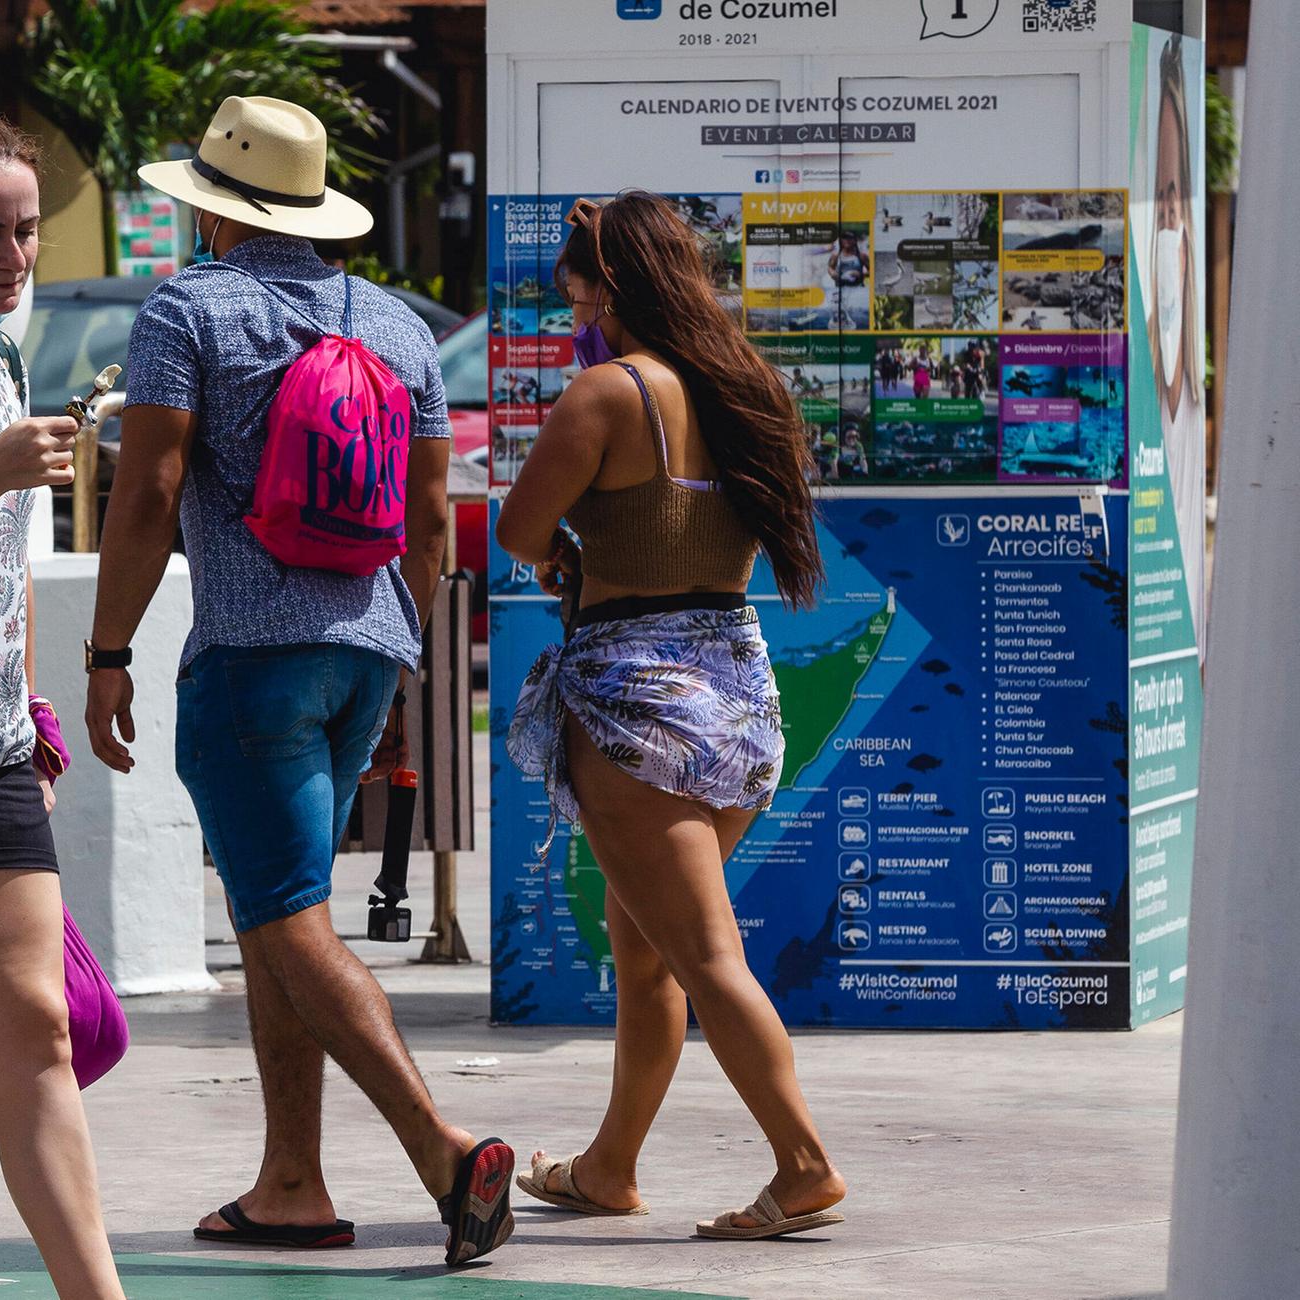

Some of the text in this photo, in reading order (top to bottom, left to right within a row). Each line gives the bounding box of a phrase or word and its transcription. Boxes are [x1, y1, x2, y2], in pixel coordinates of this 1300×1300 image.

[679, 0, 838, 19] de Cozumel
[679, 33, 758, 46] 2018 2021
[620, 98, 742, 115] CALENDARIO
[746, 98, 771, 114] DE
[863, 96, 954, 112] COZUMEL
[957, 95, 998, 111] 2021
[704, 124, 913, 142] EVENTS CALENDAR
[762, 200, 807, 218] Mayo
[505, 232, 562, 244] UNESCO
[1014, 343, 1063, 354] Diciembre
[977, 514, 1103, 539] CORAL REEF
[987, 534, 1094, 557] Arrecifes
[510, 560, 538, 583] ISL
[994, 582, 1062, 593] Chankanaab
[994, 596, 1049, 606] Tormentos
[994, 610, 1061, 620] Punta Tunich
[994, 624, 1066, 634] San Francisco
[994, 637, 1052, 647] Santa Rosa
[994, 650, 1075, 660] Paso del Cedral
[994, 664, 1056, 674] La Francesa
[994, 691, 1042, 701] Palancar
[1007, 704, 1034, 715] Cielo
[994, 718, 1046, 728] Colombia
[994, 731, 1044, 741] Punta Sur
[833, 738, 912, 750] CARIBBEAN
[994, 745, 1074, 755] Chun Chacaab
[859, 755, 885, 767] SEA
[994, 758, 1052, 769] Maracaibo
[877, 793, 938, 803] FERRY PIER
[1024, 793, 1107, 804] PUBLIC BEACH
[801, 812, 825, 820] COAST
[779, 821, 813, 829] BEACHES
[877, 826, 970, 835] INTERNACIONAL PIER
[1023, 830, 1076, 841] SNORKEL
[878, 858, 950, 868] RESTAURANT
[1024, 863, 1093, 874] HOTEL ZONE
[878, 890, 926, 901] RENTALS
[1024, 897, 1107, 906] ARCHAEOLOGICAL
[878, 925, 927, 935] NESTING
[1024, 928, 1107, 938] SCUBA DIVING
[838, 974, 958, 991] #VisitCozumel
[855, 988, 957, 1001] WithConfidence
[1014, 987, 1109, 1009] TeEspera
